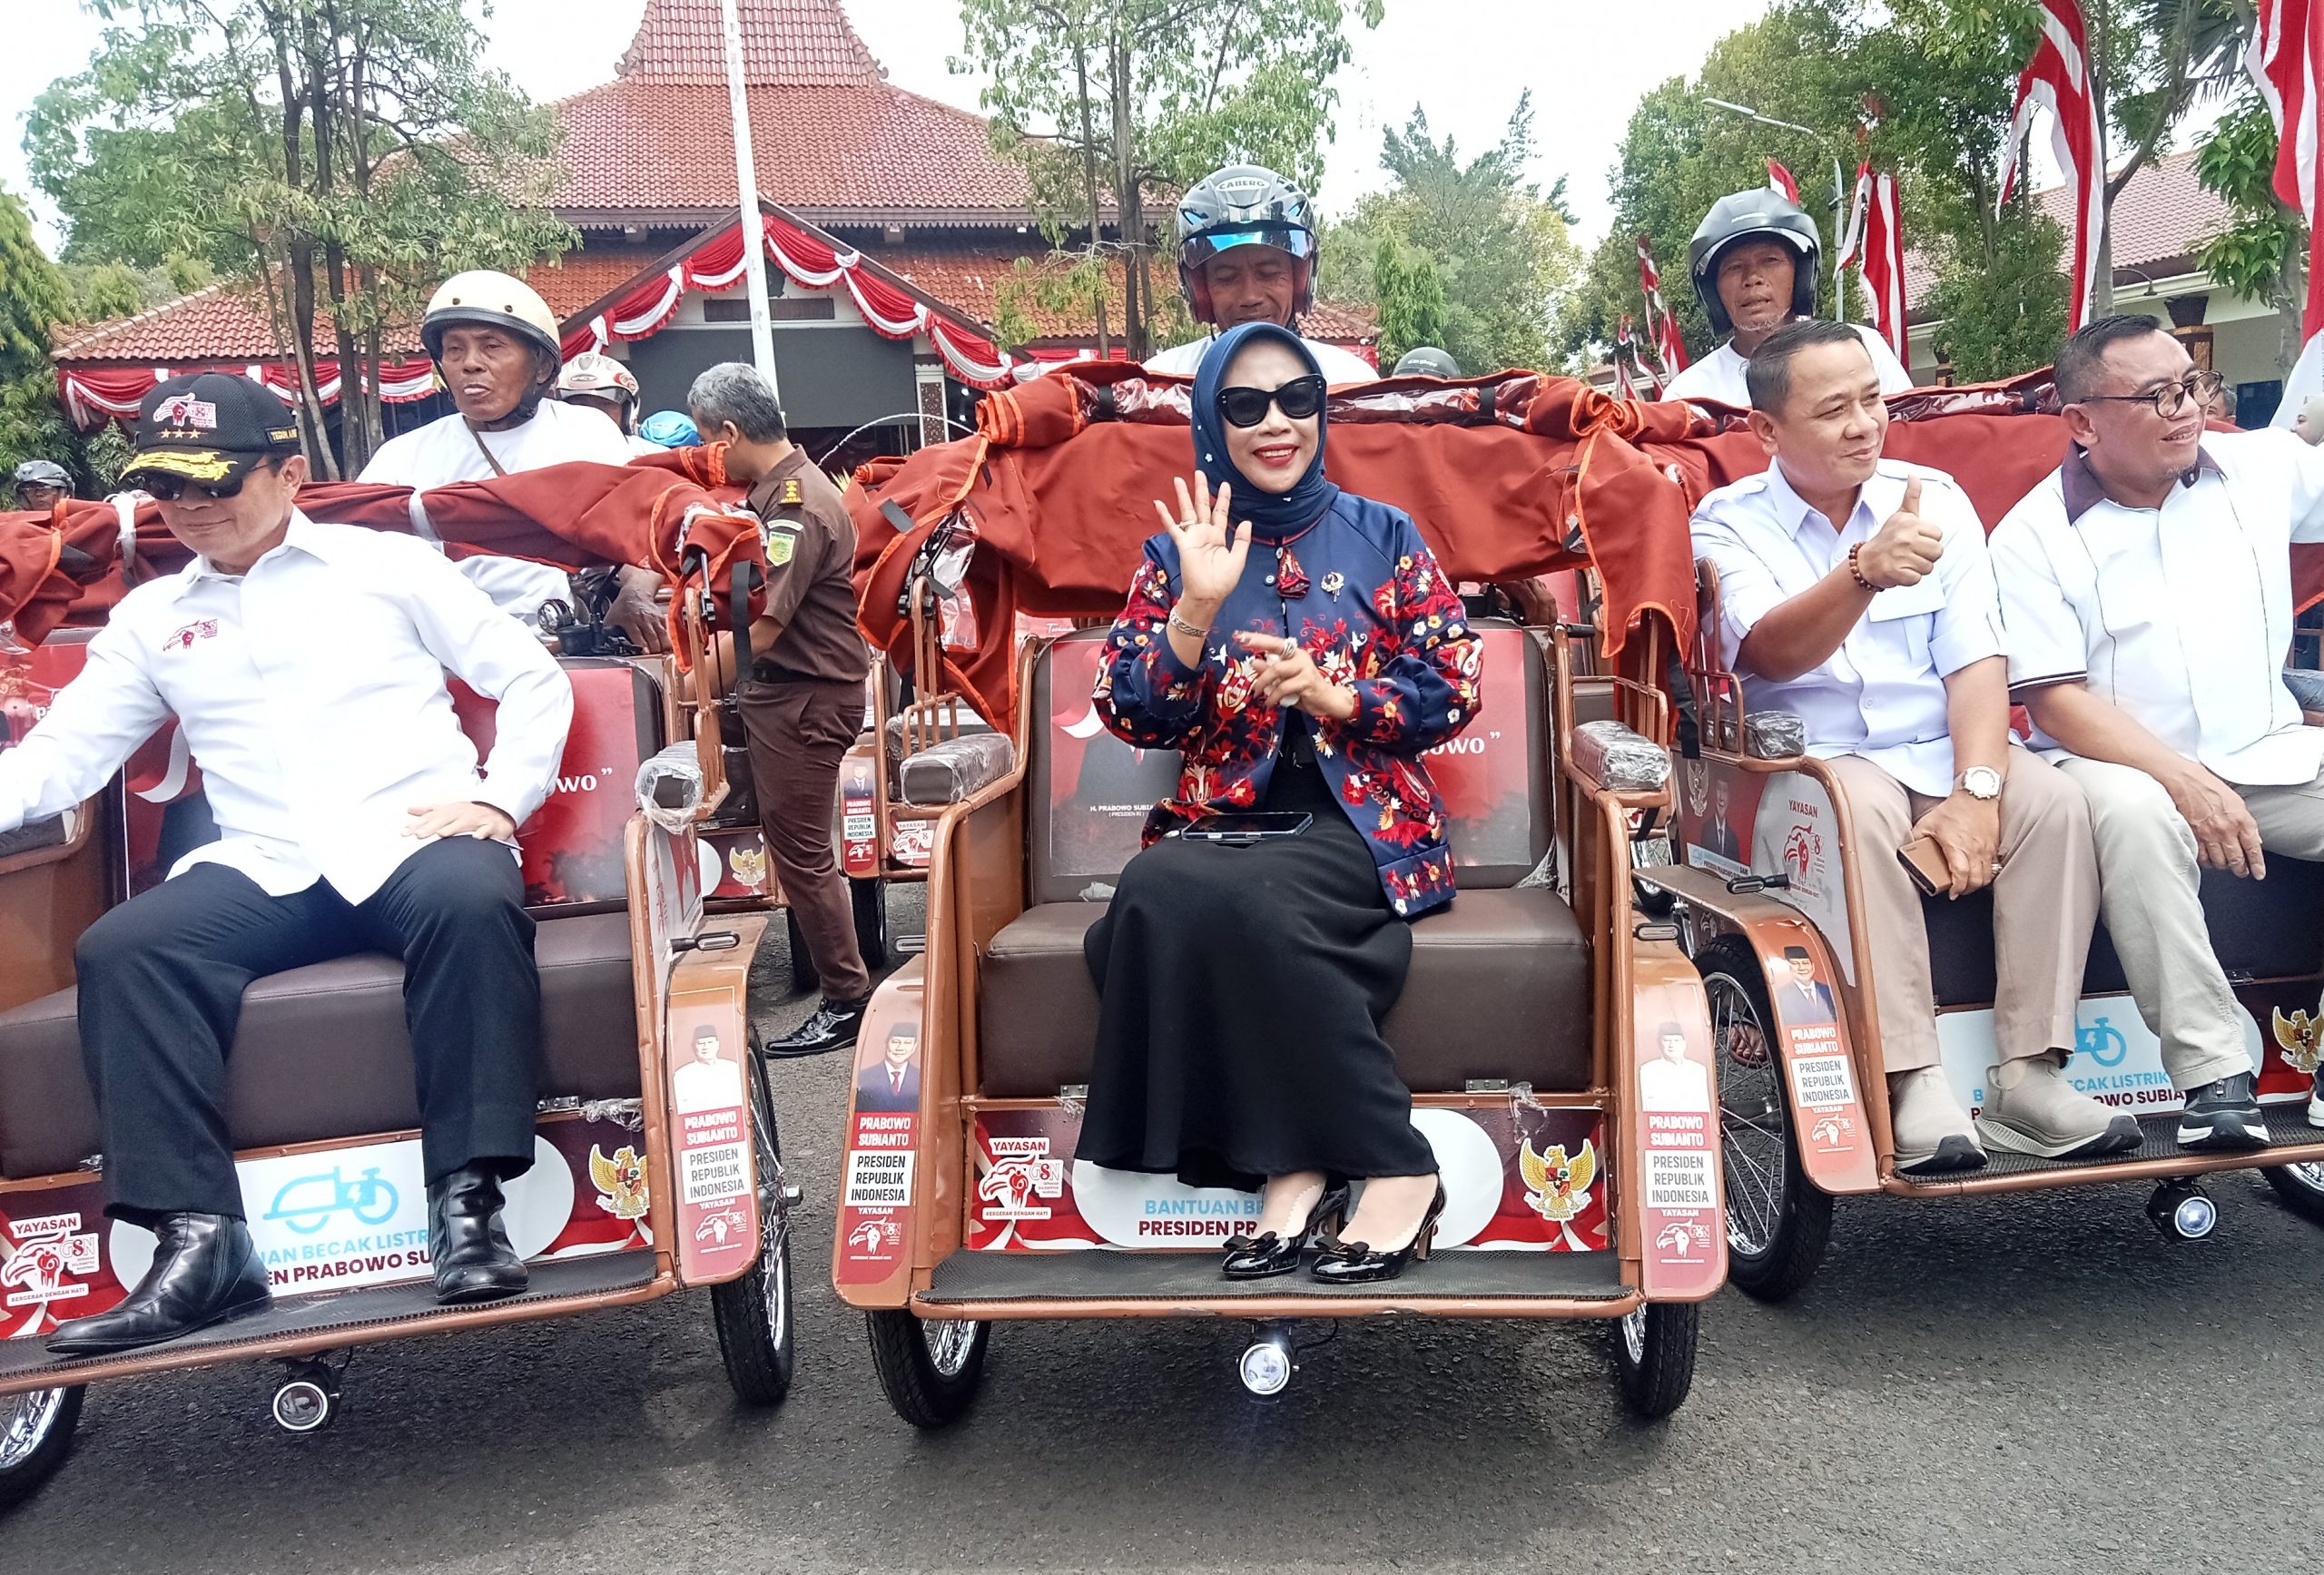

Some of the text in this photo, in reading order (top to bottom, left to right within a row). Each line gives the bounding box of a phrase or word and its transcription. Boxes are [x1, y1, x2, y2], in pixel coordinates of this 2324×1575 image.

[1218, 180, 1265, 190] CABERG
[1788, 799, 1818, 819] YAYASAN
[1790, 1027, 1837, 1040] PRABOWO
[1794, 1041, 1838, 1055] SUBIANTO
[1799, 1060, 1842, 1073] PRESIDEN
[1802, 1075, 1845, 1088] REPUBLIK
[2112, 1071, 2169, 1088] LISTRIK
[1802, 1089, 1850, 1102] INDONESIA
[1811, 1106, 1844, 1114] YAYASAN
[684, 1110, 737, 1130] PRABOWO
[859, 1117, 911, 1130] PRABOWO
[1649, 1116, 1704, 1130] PRABOWO
[1838, 1117, 1856, 1129] GSN
[685, 1126, 738, 1146] SUBIANTO
[858, 1133, 909, 1147] SUBIANTO
[1649, 1132, 1705, 1147] SUBIANTO
[993, 1141, 1046, 1151] YAYASAN
[689, 1148, 738, 1166] PRESIDEN
[857, 1156, 906, 1168] PRESIDEN
[1653, 1156, 1704, 1168] PRESIDEN
[691, 1164, 740, 1182] REPUBLIK
[855, 1172, 904, 1185] REPUBLIK
[1654, 1173, 1705, 1186] REPUBLIK
[690, 1178, 744, 1199] INDONESIA
[851, 1188, 905, 1201] INDONESIA
[1652, 1189, 1709, 1203] INDONESIA
[699, 1197, 736, 1210] YAYASAN
[1145, 1199, 1236, 1215] BANTUAN
[726, 1210, 747, 1225] GSN
[857, 1206, 893, 1216] YAYASAN
[1660, 1208, 1699, 1217] YAYASAN
[15, 1216, 77, 1235] YAYASAN
[881, 1222, 901, 1236] GSN
[1138, 1220, 1229, 1235] PRESIDEN
[1689, 1225, 1710, 1238] GSN
[302, 1236, 372, 1260] BECAK
[293, 1253, 402, 1283] PRABOWO
[11, 1294, 44, 1303] BERGERAK
